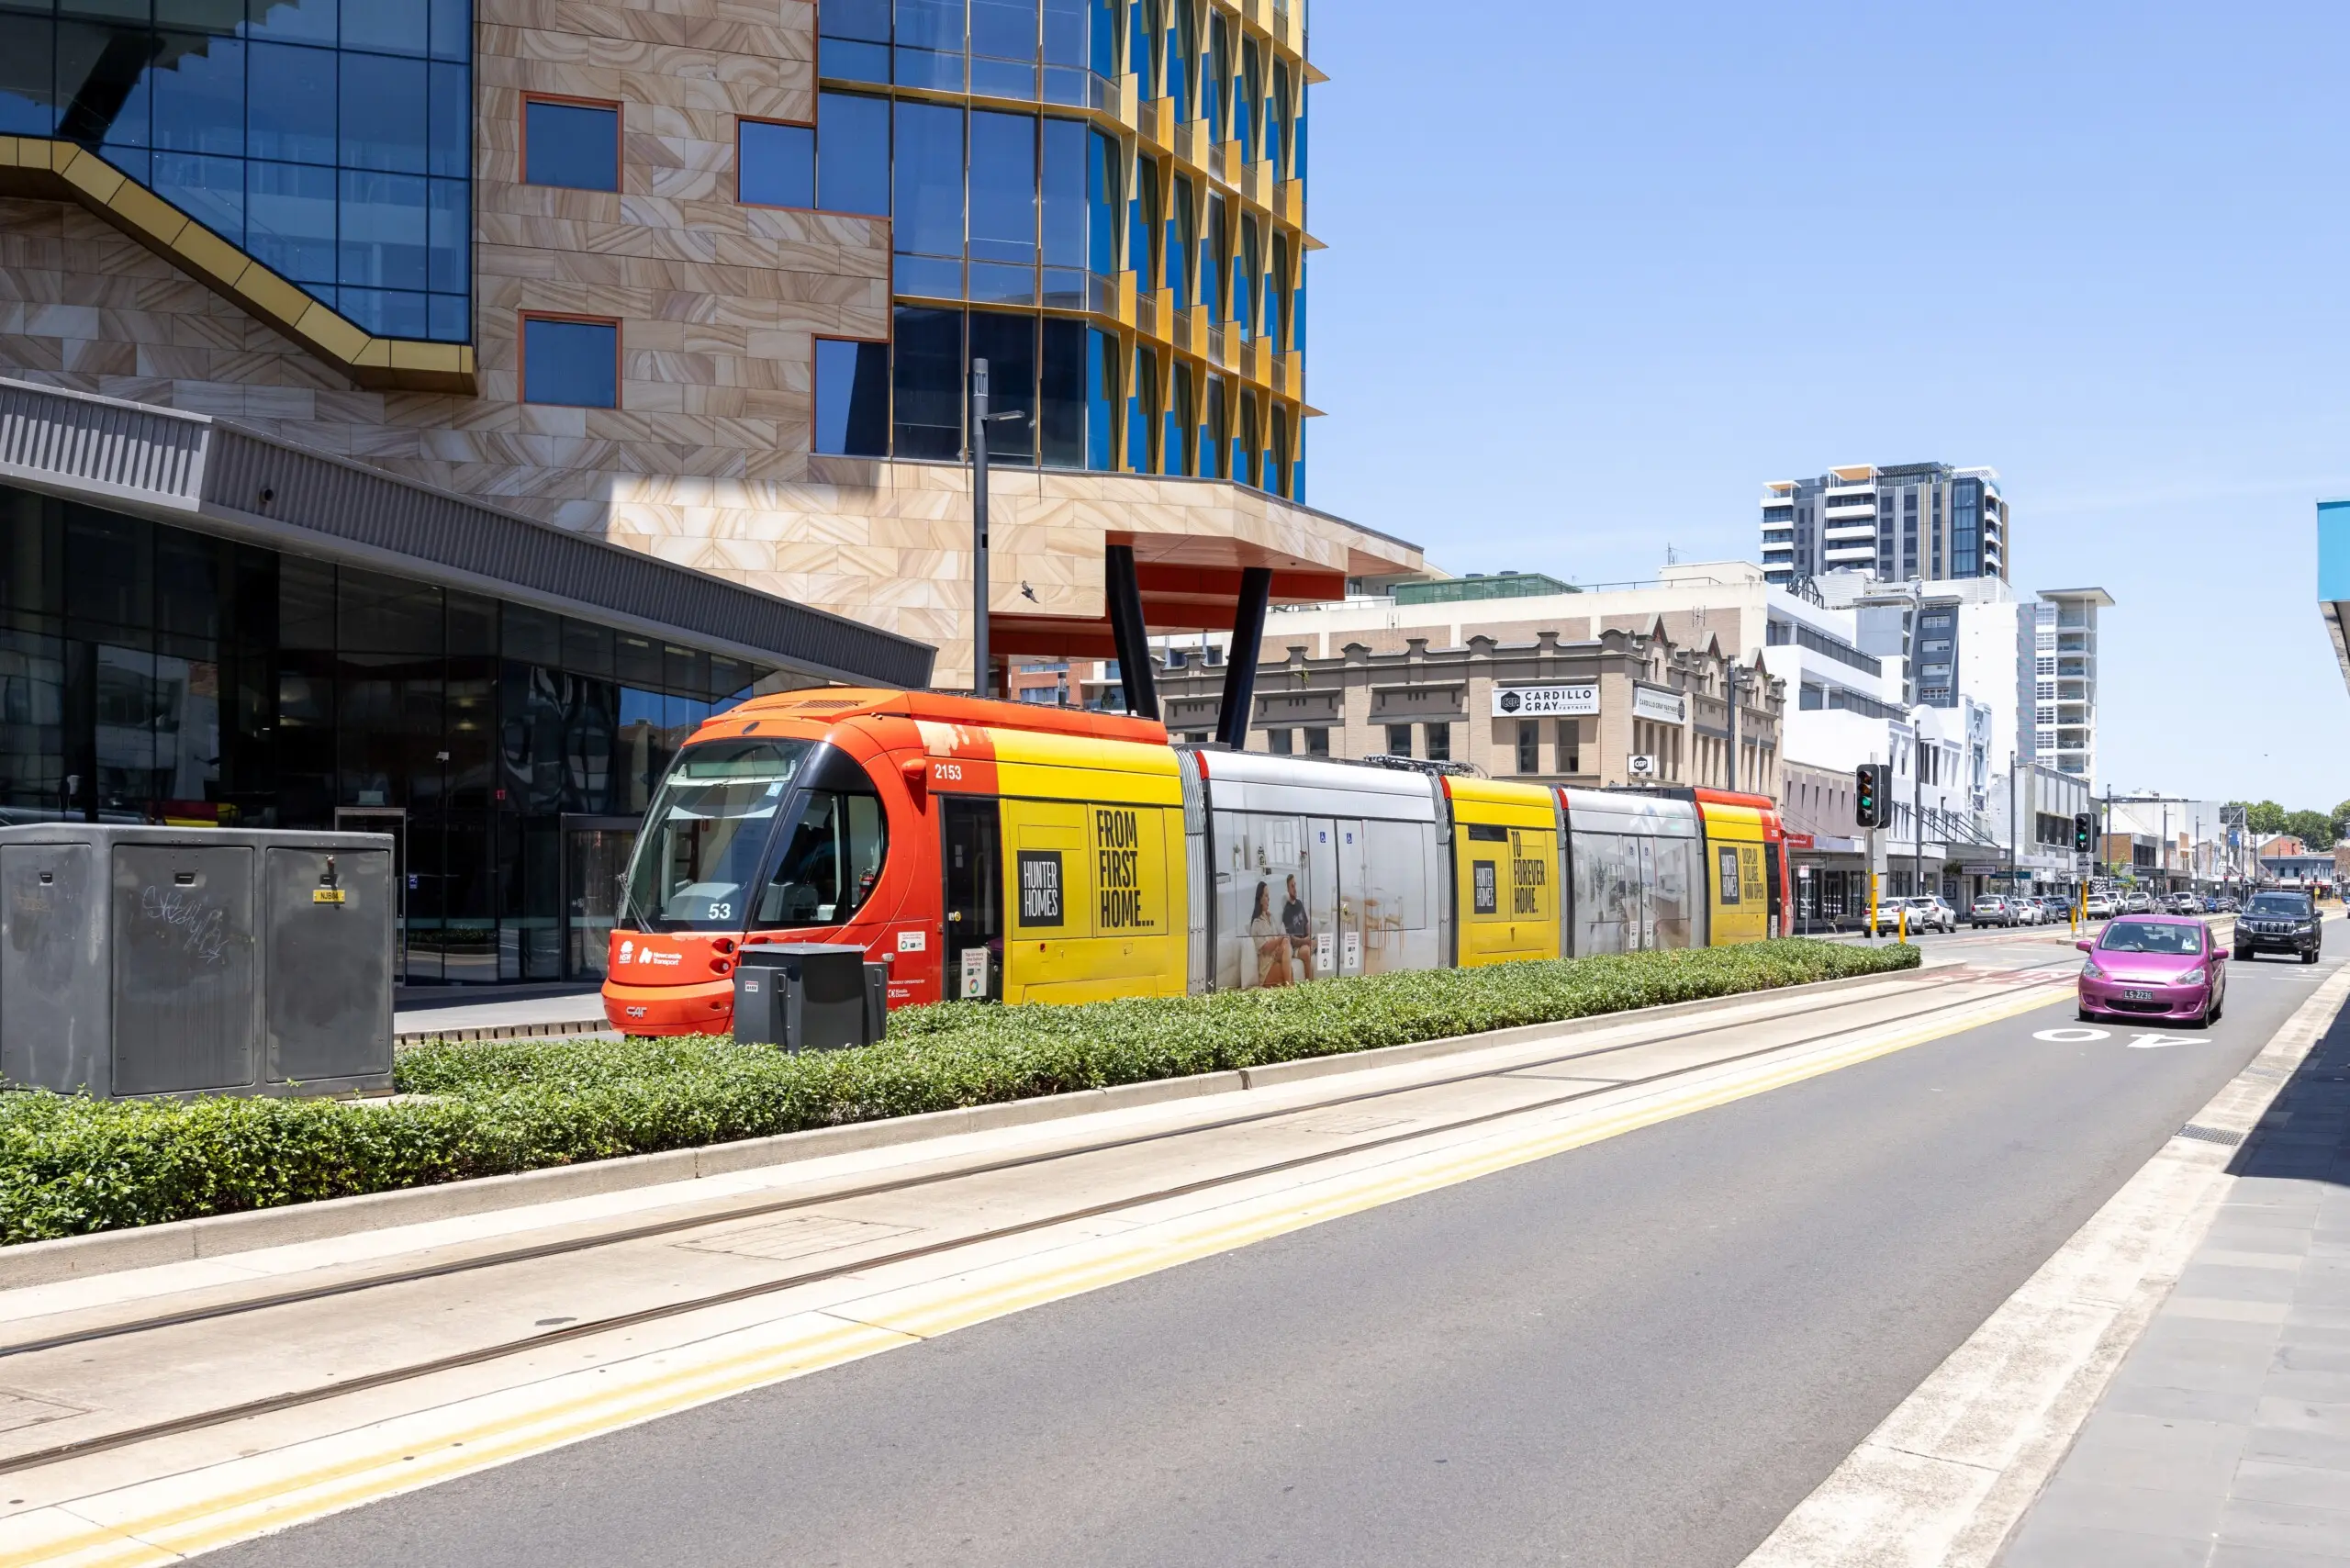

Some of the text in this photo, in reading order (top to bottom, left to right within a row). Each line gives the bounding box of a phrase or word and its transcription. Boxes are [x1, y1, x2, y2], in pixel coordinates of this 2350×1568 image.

[1525, 689, 1592, 700] CARDILLO
[1639, 699, 1655, 709] CARDILLO
[1525, 702, 1559, 711] GRAY
[934, 764, 962, 780] 2153
[1096, 810, 1138, 848] FROM
[1511, 831, 1522, 857] TO
[1720, 855, 1737, 875] HUNTER
[1742, 848, 1758, 864] DISPLAY
[1023, 860, 1058, 889] HUNTER
[1099, 849, 1138, 888] FIRST
[1476, 868, 1494, 887] HUNTER
[1513, 858, 1546, 886] FOREVER
[1743, 866, 1759, 881] VILLAGE
[1722, 876, 1738, 897] HOMES
[1744, 882, 1763, 900] NOW OPEN
[1024, 889, 1058, 917] HOMES
[1476, 887, 1494, 907] HOMES
[1514, 887, 1539, 914] HOME.
[708, 903, 732, 919] 53
[653, 951, 683, 960] Newcastle
